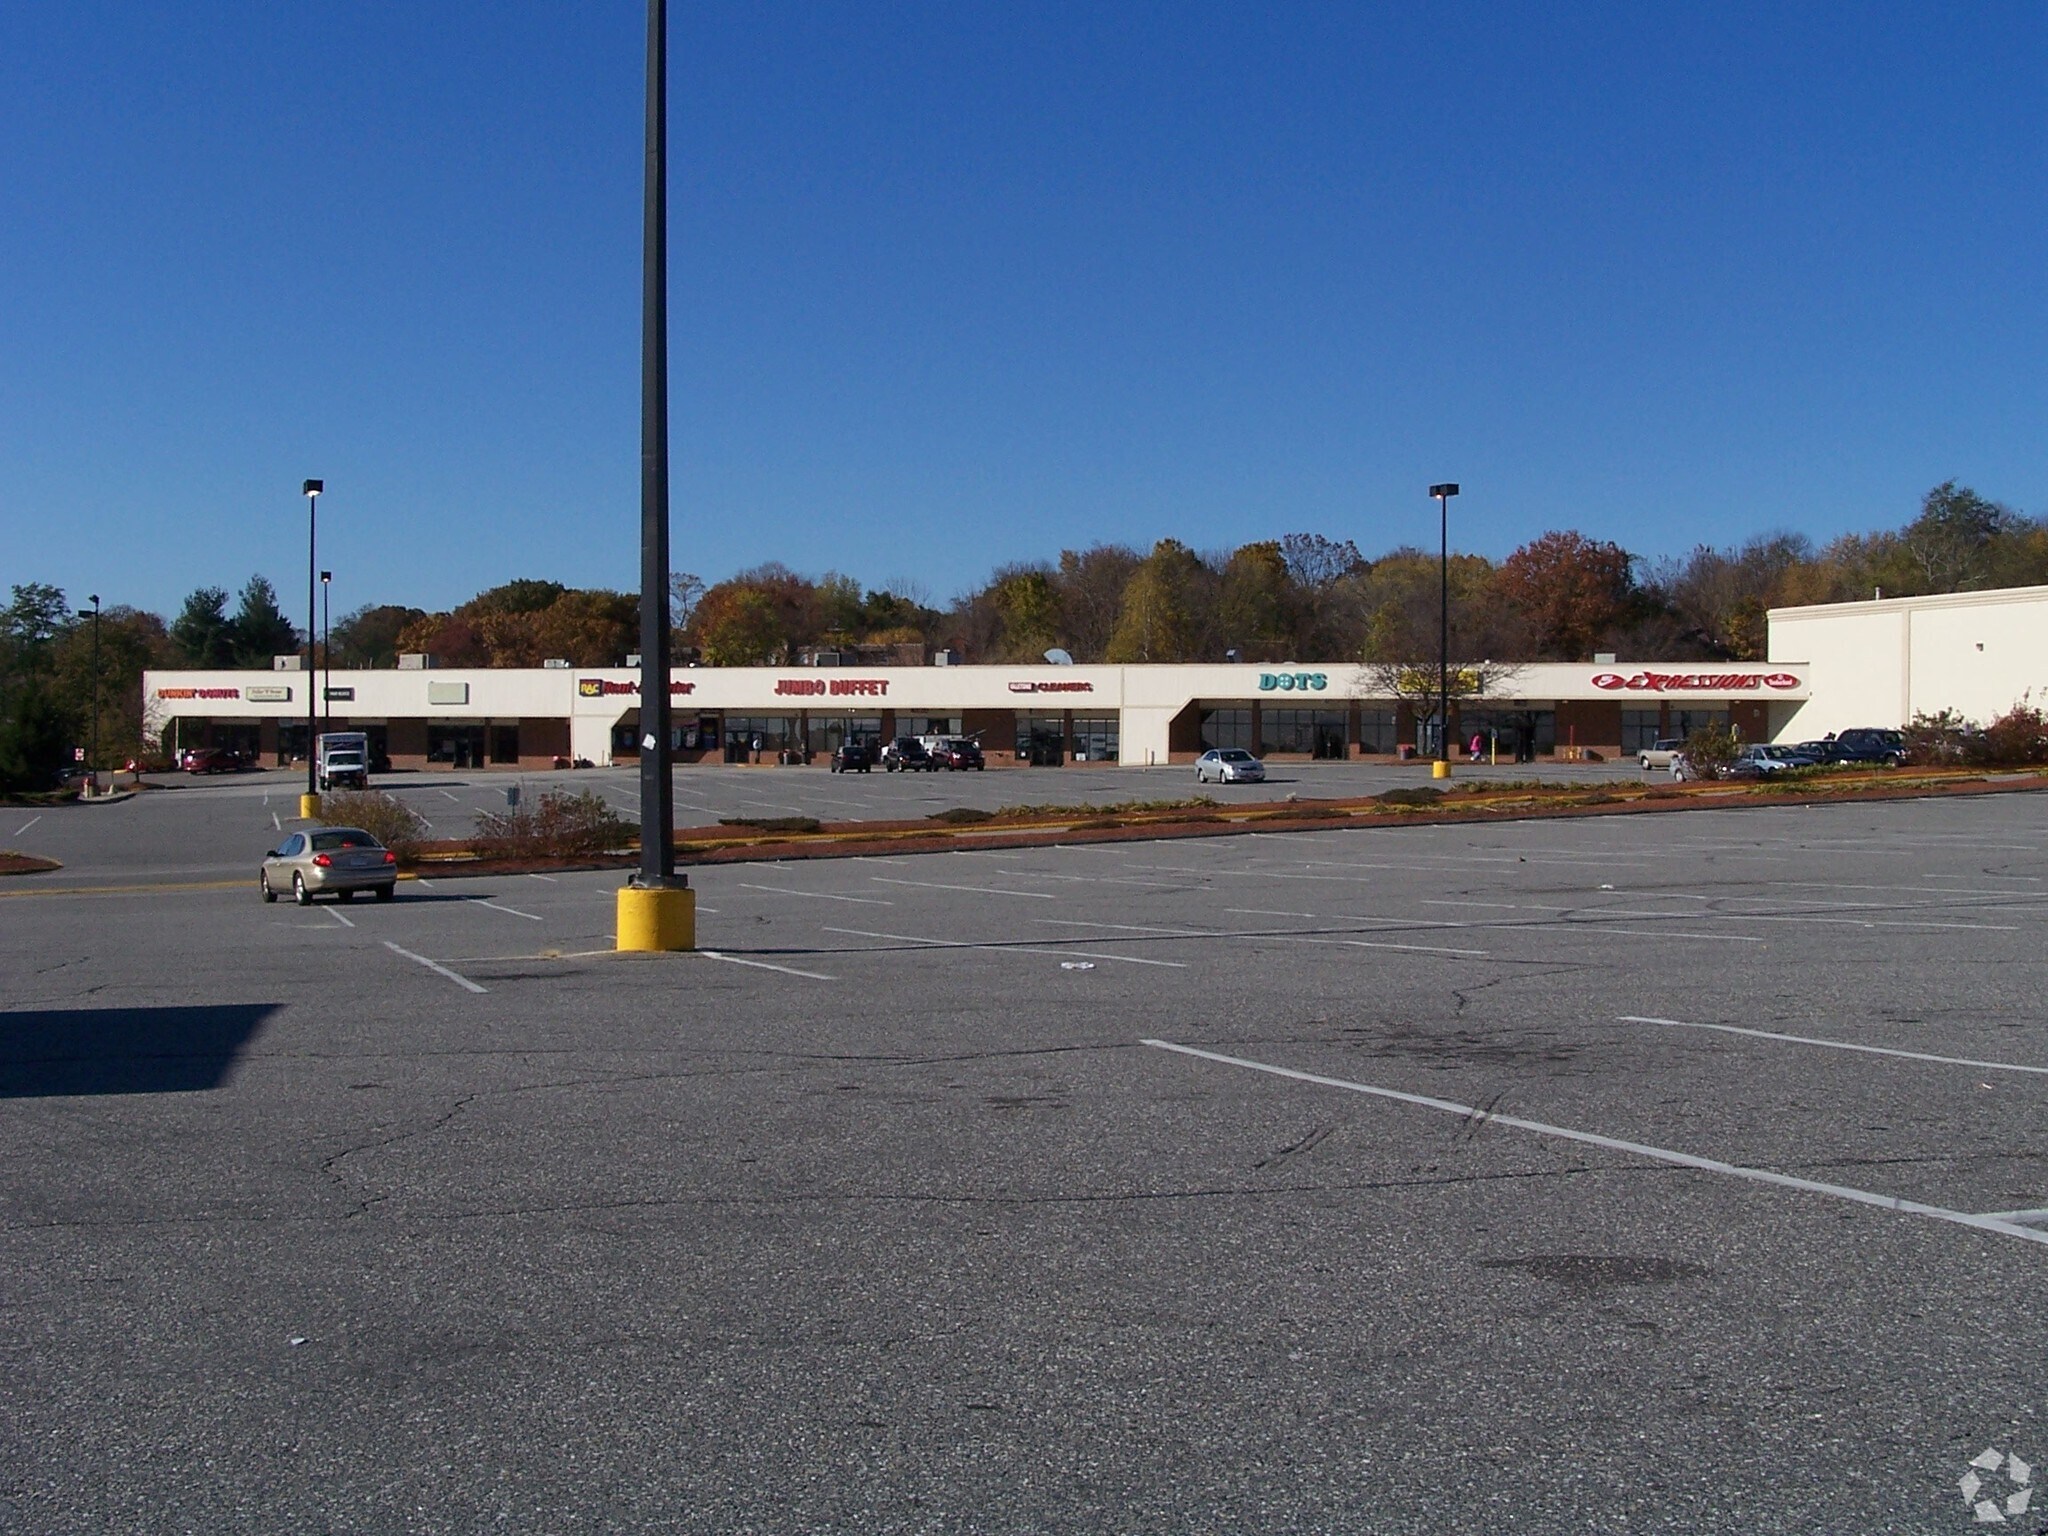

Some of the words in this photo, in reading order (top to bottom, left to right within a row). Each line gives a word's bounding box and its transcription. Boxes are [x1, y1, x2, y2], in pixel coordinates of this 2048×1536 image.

[774, 679, 826, 695] JUMBO
[829, 679, 889, 695] BUFFET
[1258, 673, 1328, 691] DOTS
